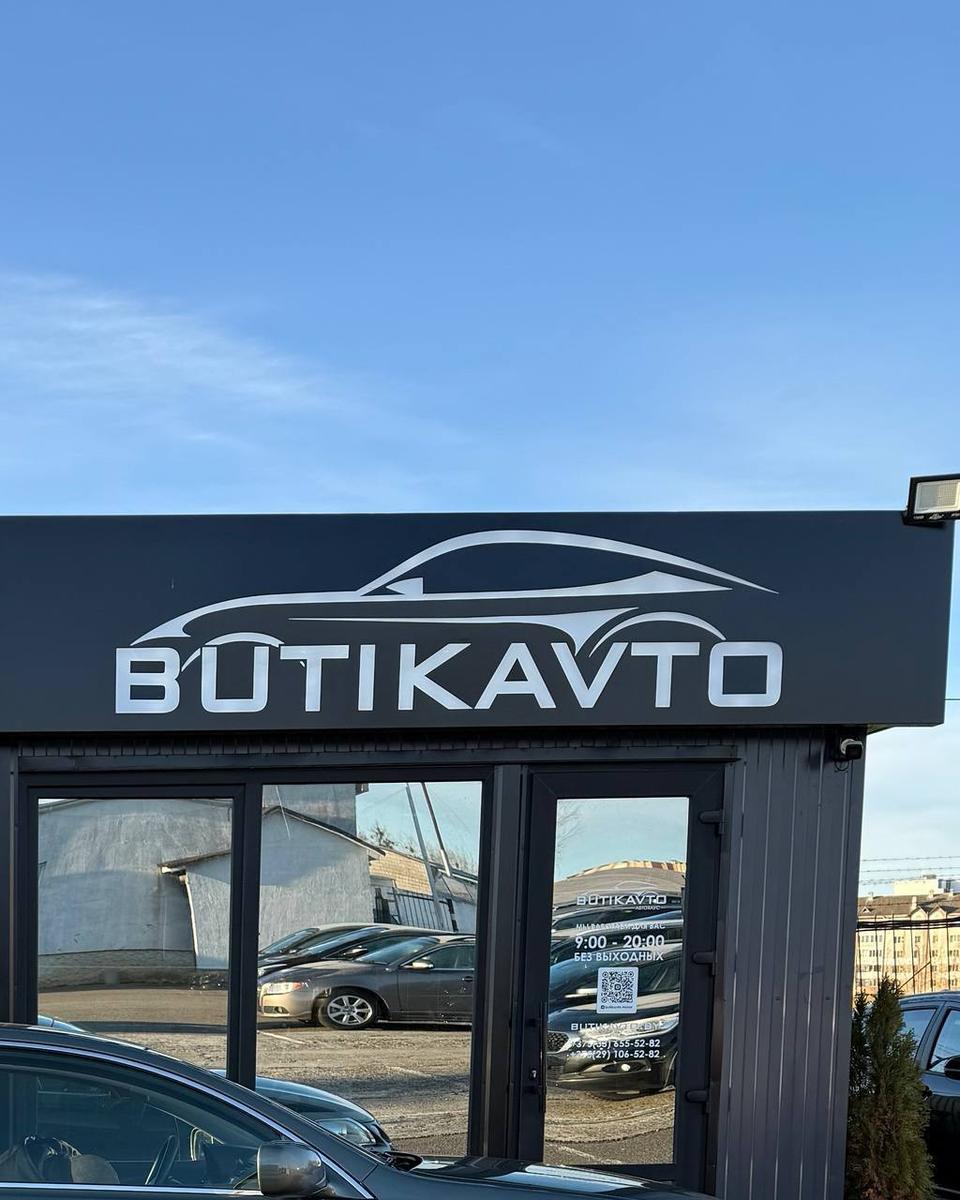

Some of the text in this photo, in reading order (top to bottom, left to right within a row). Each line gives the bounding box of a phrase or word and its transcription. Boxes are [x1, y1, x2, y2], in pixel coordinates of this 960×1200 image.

[115, 641, 784, 714] BUTIKAVTO
[576, 895, 667, 906] BUTIKAVTO
[575, 935, 607, 949] 9:00
[623, 934, 665, 949] 20:00
[574, 951, 664, 962] БЕЗ ВЫХОДНЫХ
[613, 1038, 661, 1048] 655-52-82
[614, 1049, 660, 1058] 106-52-82
